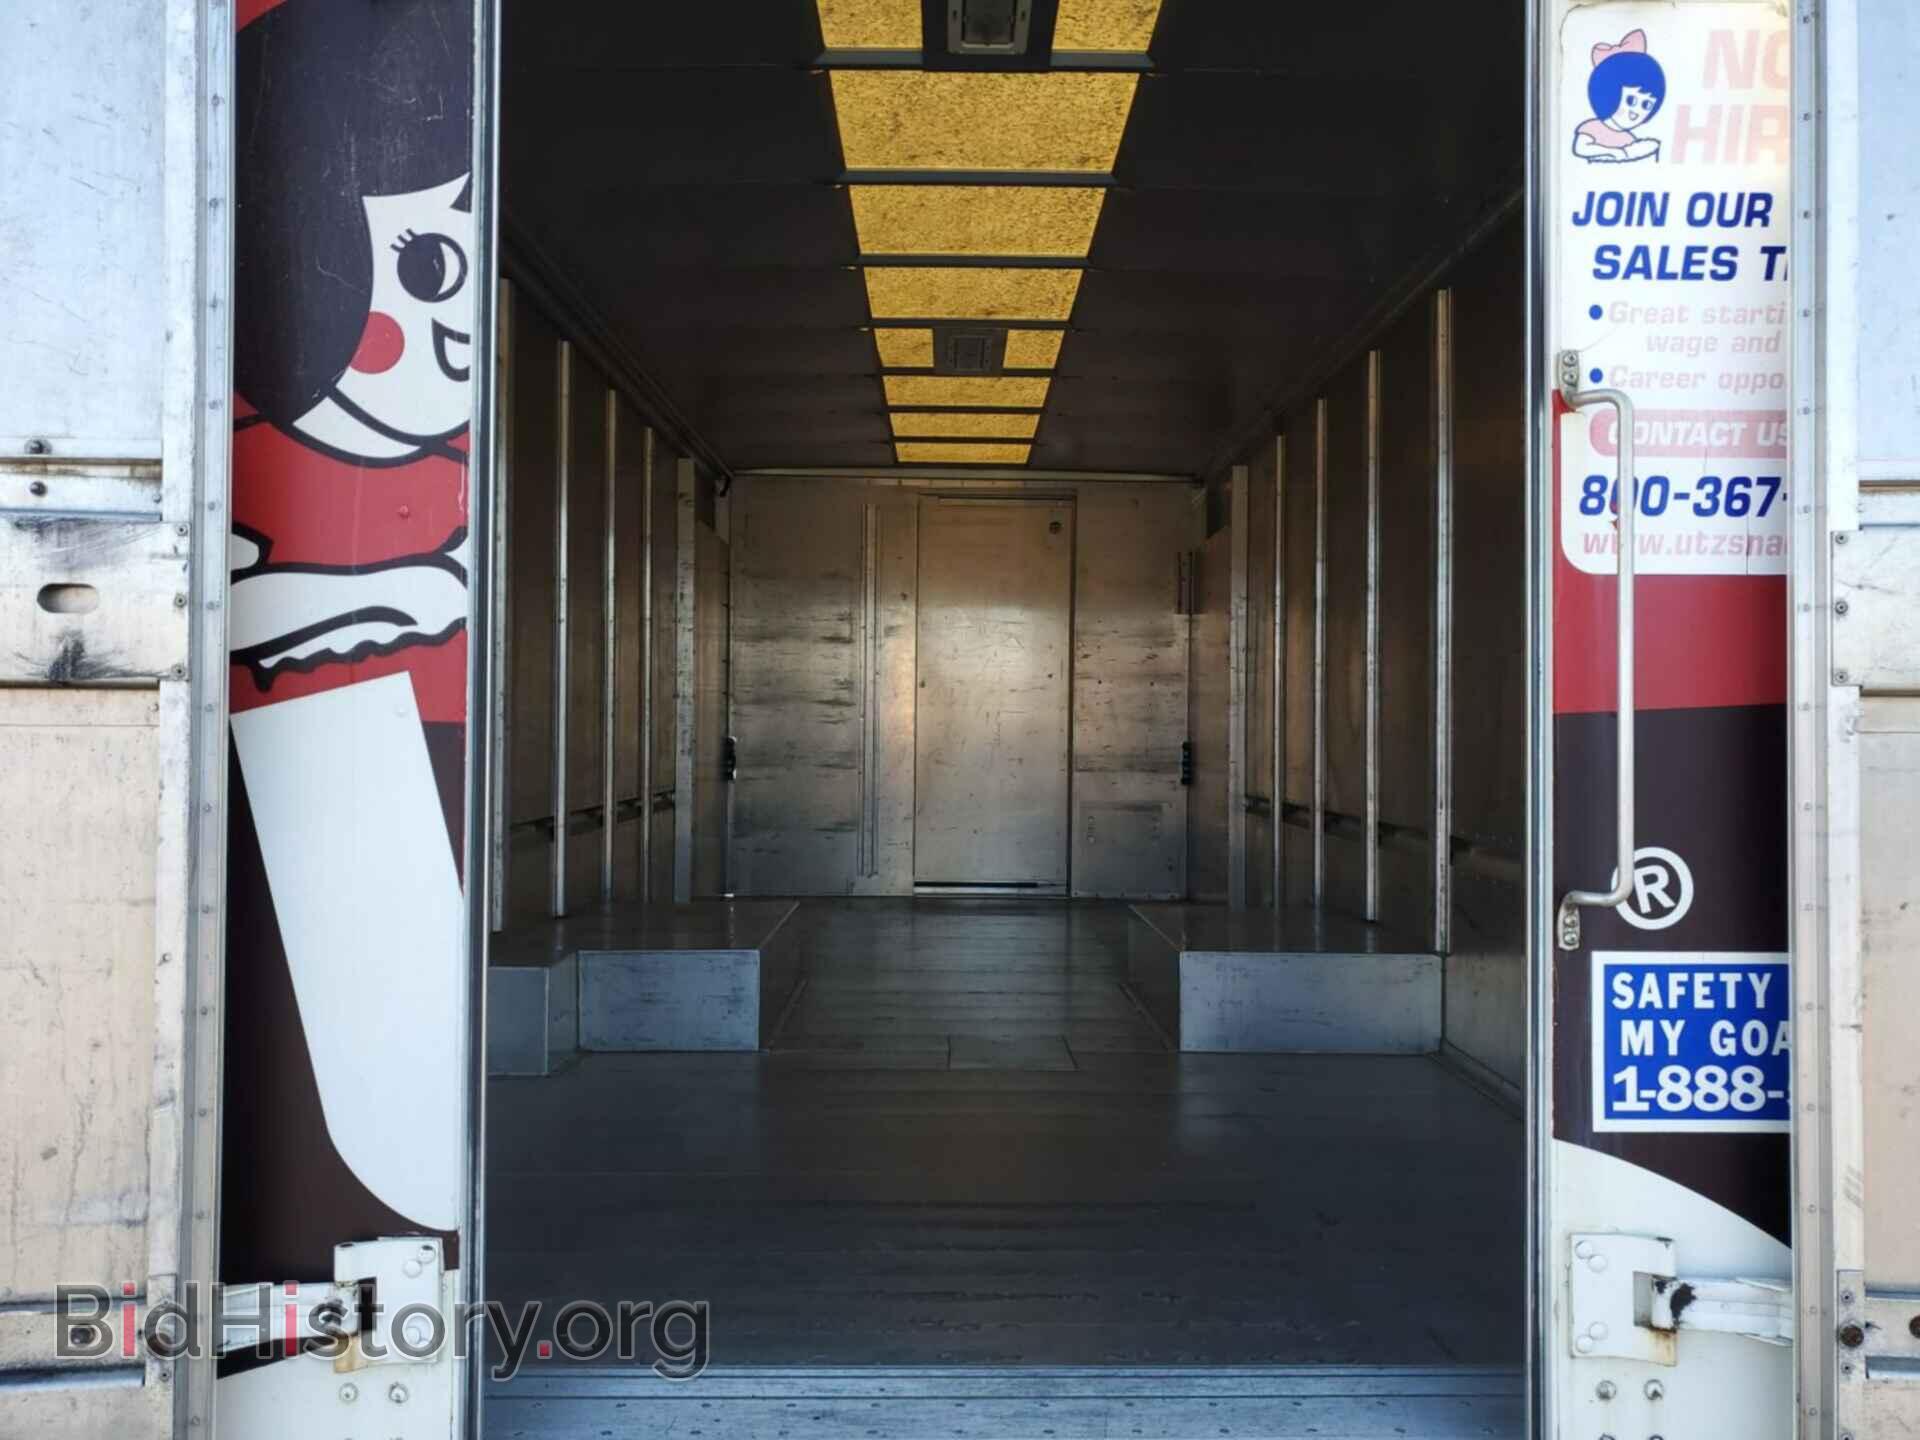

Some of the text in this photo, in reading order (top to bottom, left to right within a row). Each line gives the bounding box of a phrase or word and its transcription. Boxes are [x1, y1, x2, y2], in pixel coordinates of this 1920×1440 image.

[1571, 191, 1773, 228] JOIN OUR
[1592, 244, 1788, 281] SALES T
[1607, 301, 1690, 325] Great
[1646, 329, 1782, 357] wage and
[1607, 365, 1707, 389] Career
[1611, 972, 1773, 1009] SAFETY
[1620, 1019, 1686, 1056] MY
[1612, 1064, 1790, 1112] 1-888-
